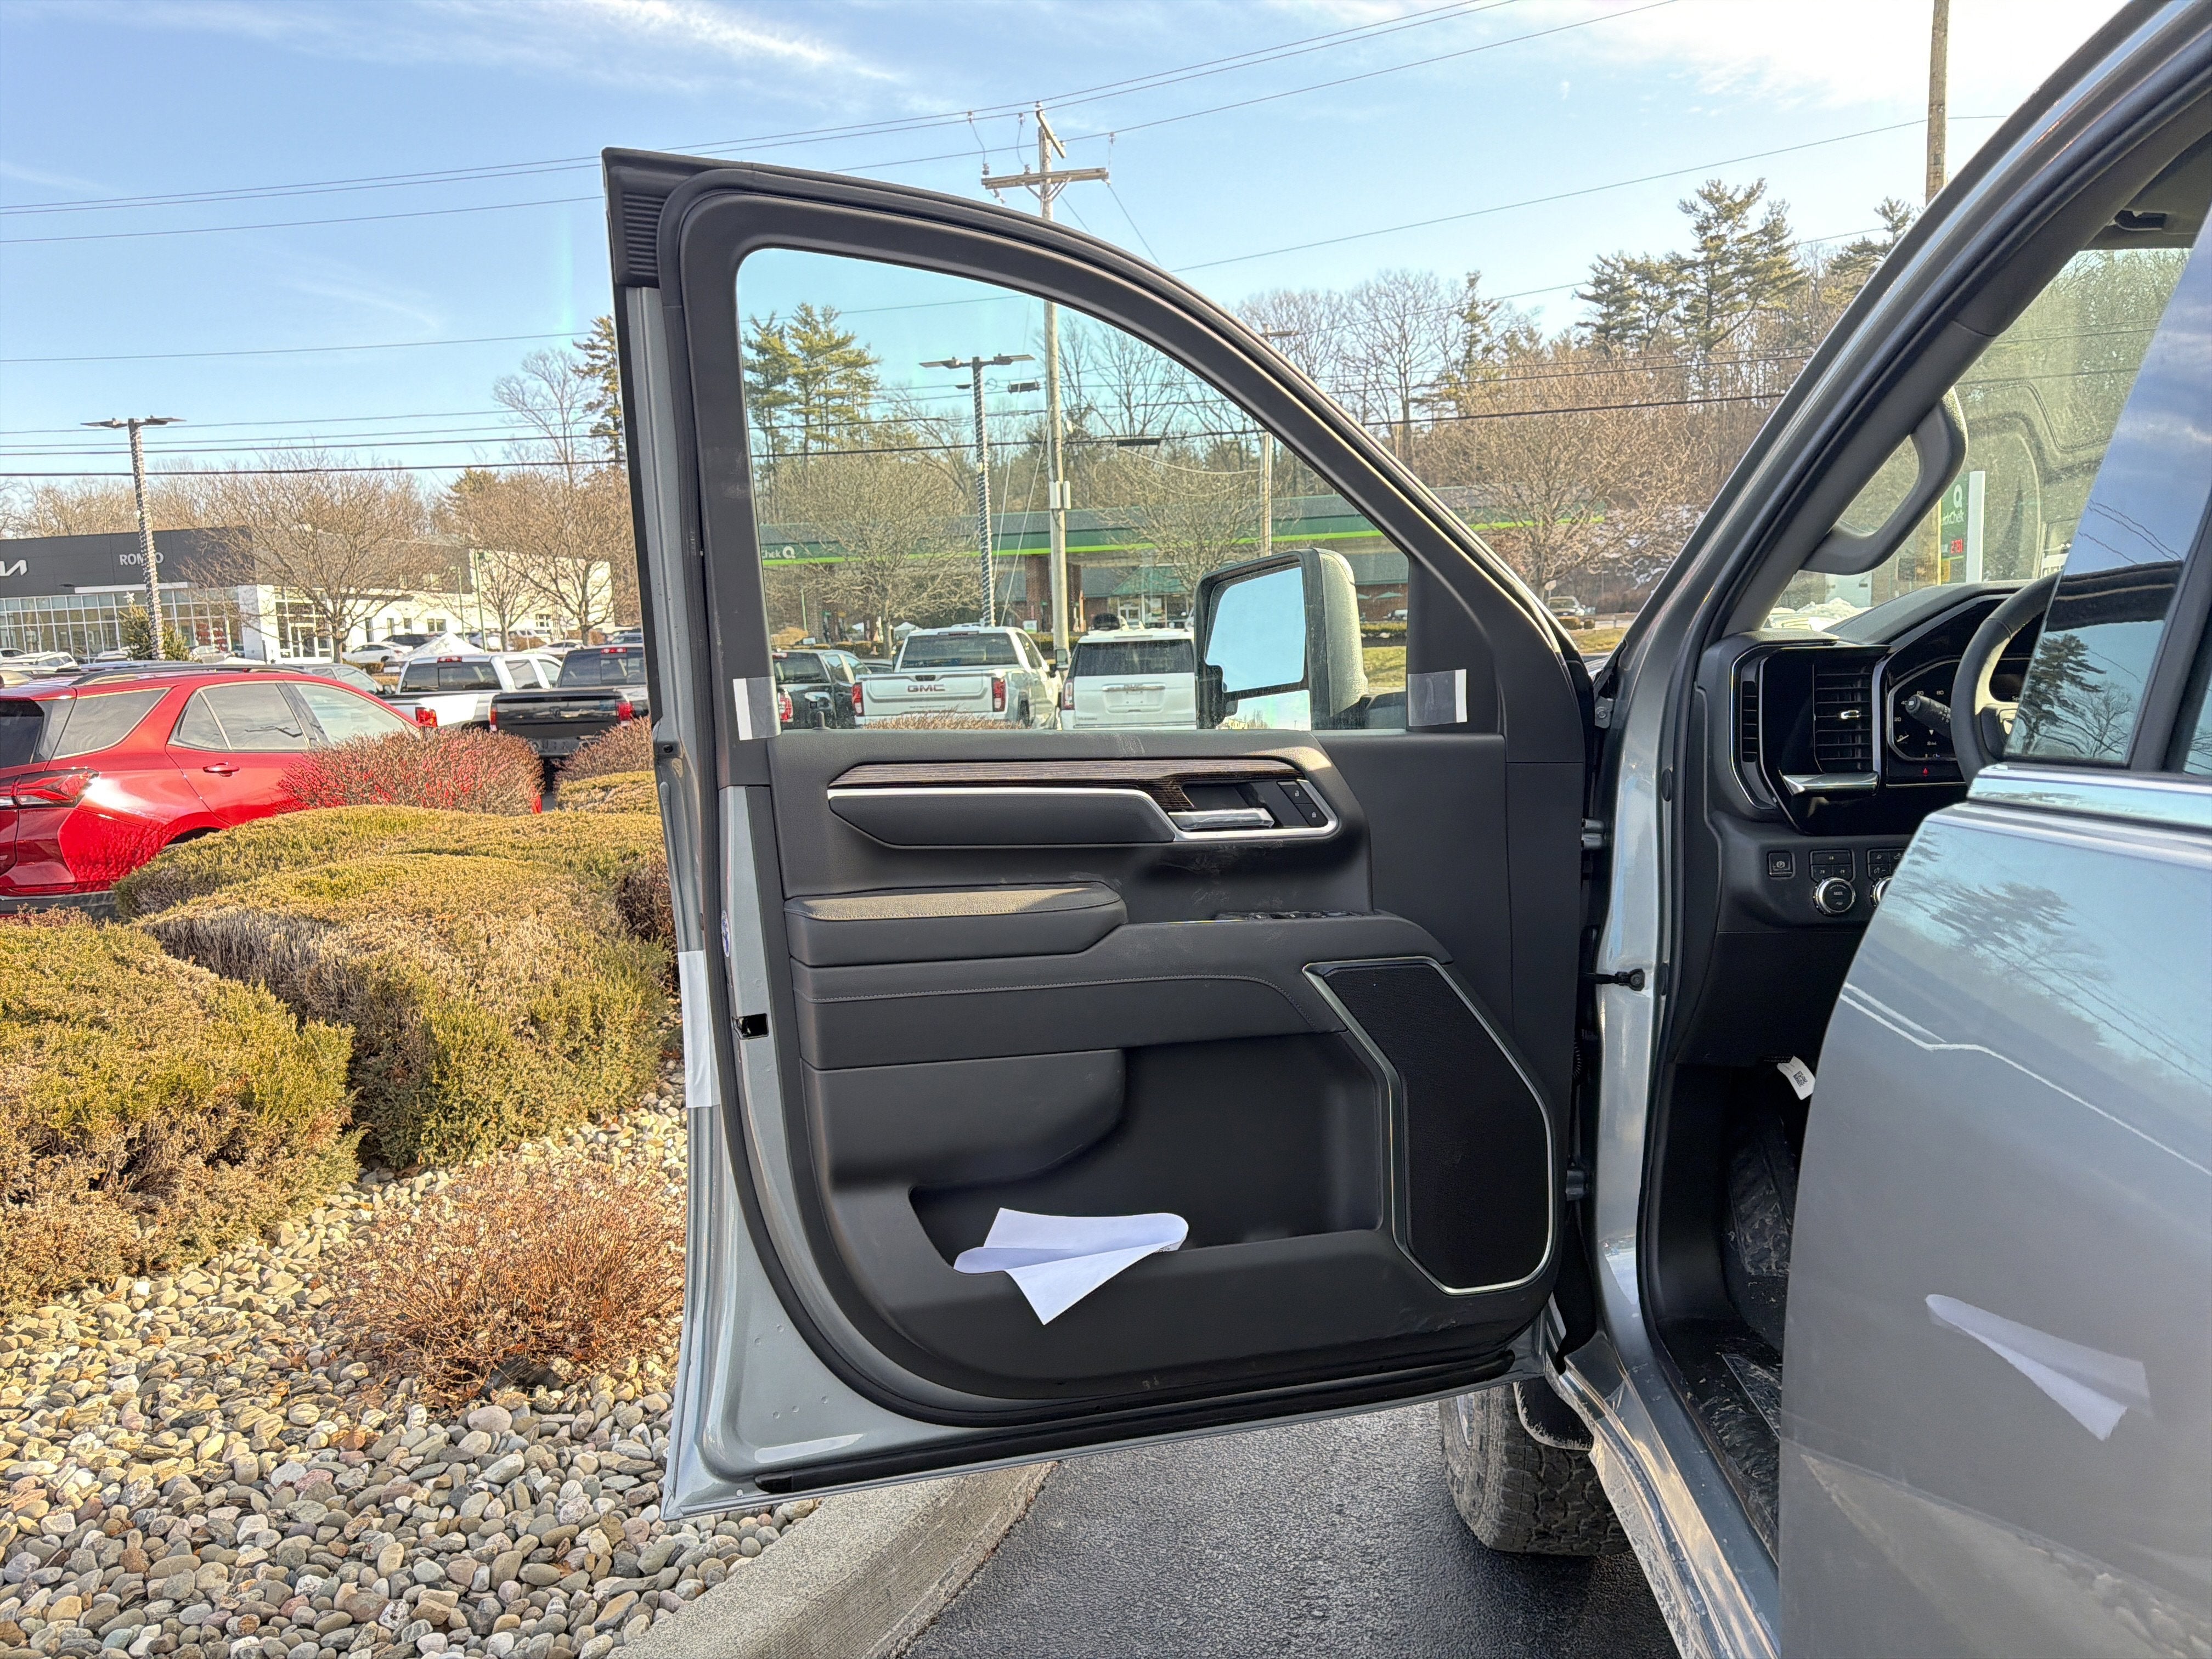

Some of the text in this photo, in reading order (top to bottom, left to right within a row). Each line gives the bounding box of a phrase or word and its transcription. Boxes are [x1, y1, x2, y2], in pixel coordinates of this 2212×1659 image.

[782, 545, 795, 558] Q
[119, 552, 164, 566] ROMO
[907, 684, 945, 692] GMC
